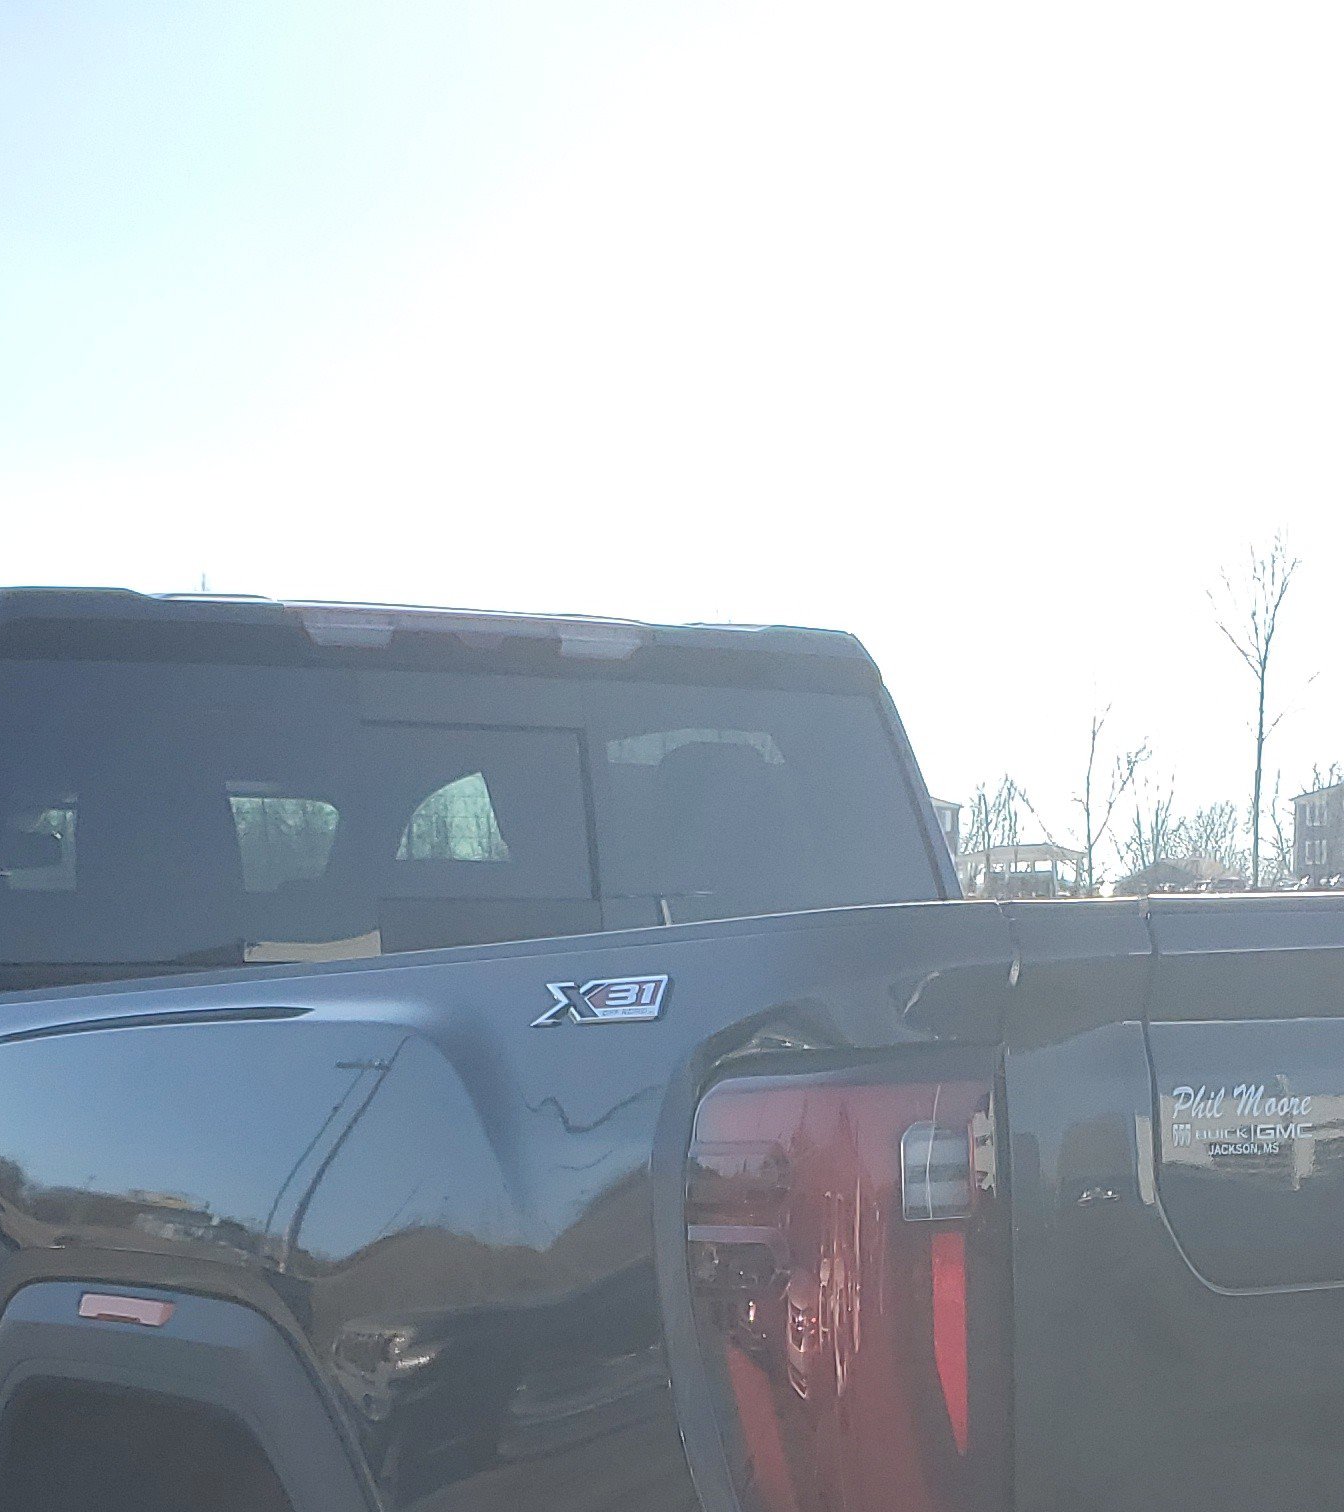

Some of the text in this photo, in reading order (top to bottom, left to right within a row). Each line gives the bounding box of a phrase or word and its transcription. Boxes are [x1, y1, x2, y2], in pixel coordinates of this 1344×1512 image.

[530, 974, 668, 1025] X31
[1172, 1083, 1312, 1119] Phil Moore
[1256, 1122, 1314, 1139] GMC
[1208, 1142, 1279, 1156] JACKSON, MS
